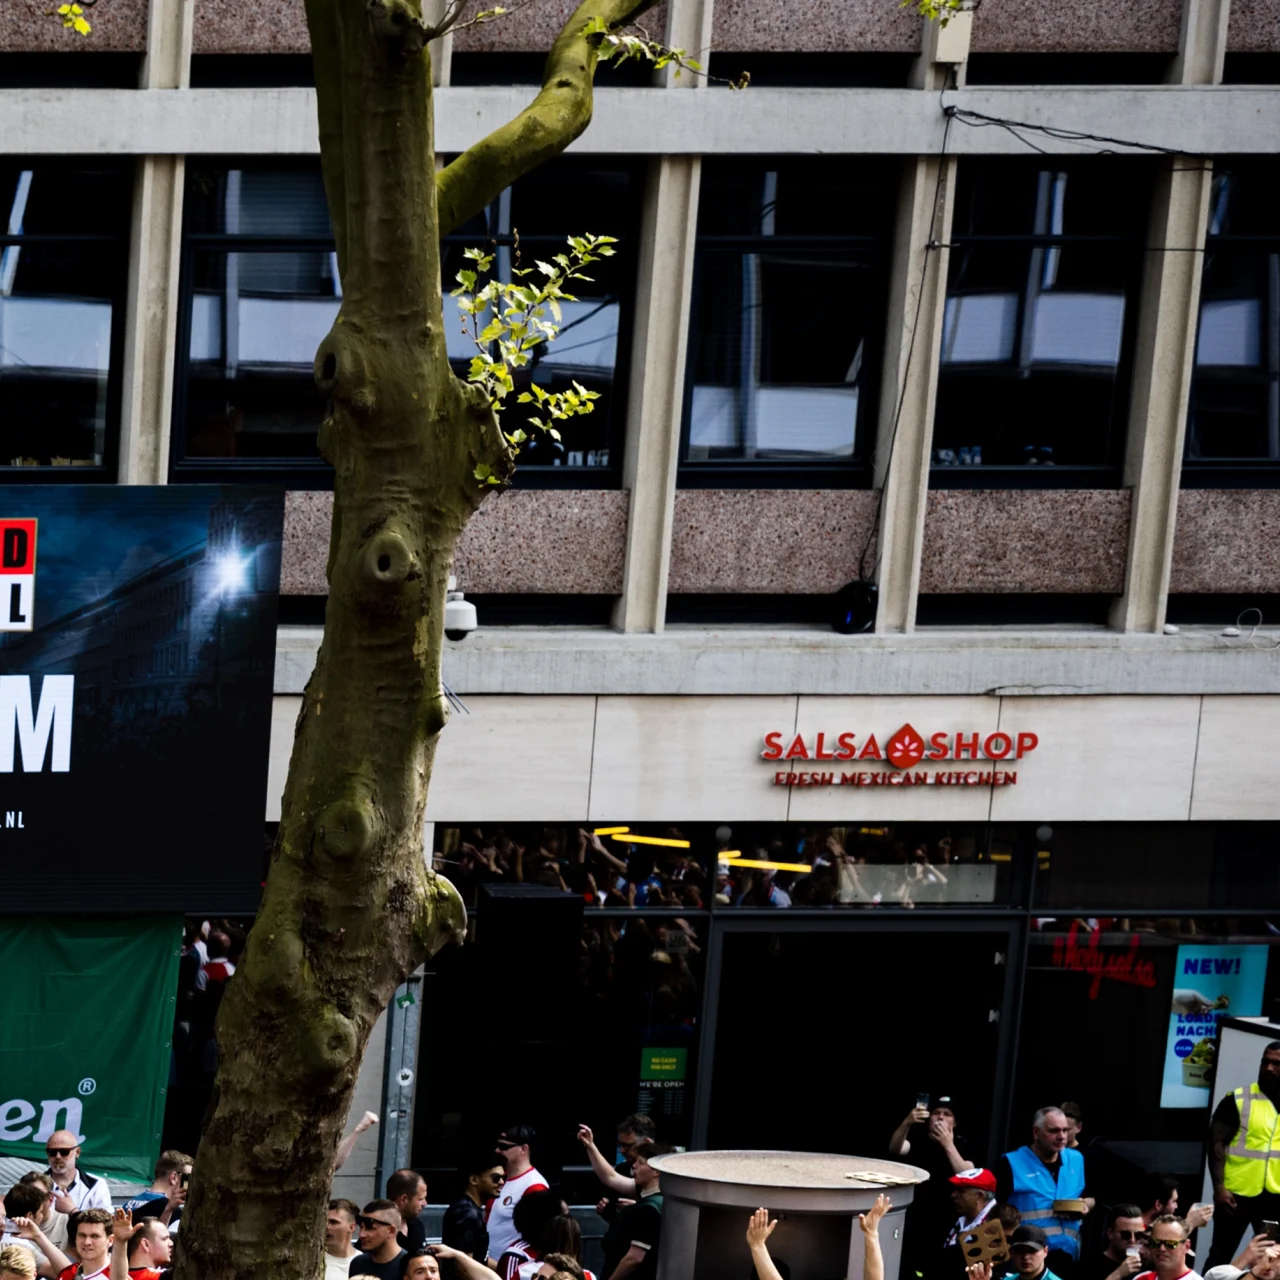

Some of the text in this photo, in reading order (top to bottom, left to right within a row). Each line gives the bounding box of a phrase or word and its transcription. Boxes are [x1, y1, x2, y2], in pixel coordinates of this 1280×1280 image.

[762, 731, 1038, 761] SALSA SHOP
[774, 771, 1017, 787] FRESH MEXICAN KITCHEN
[1183, 958, 1241, 976] NEW!
